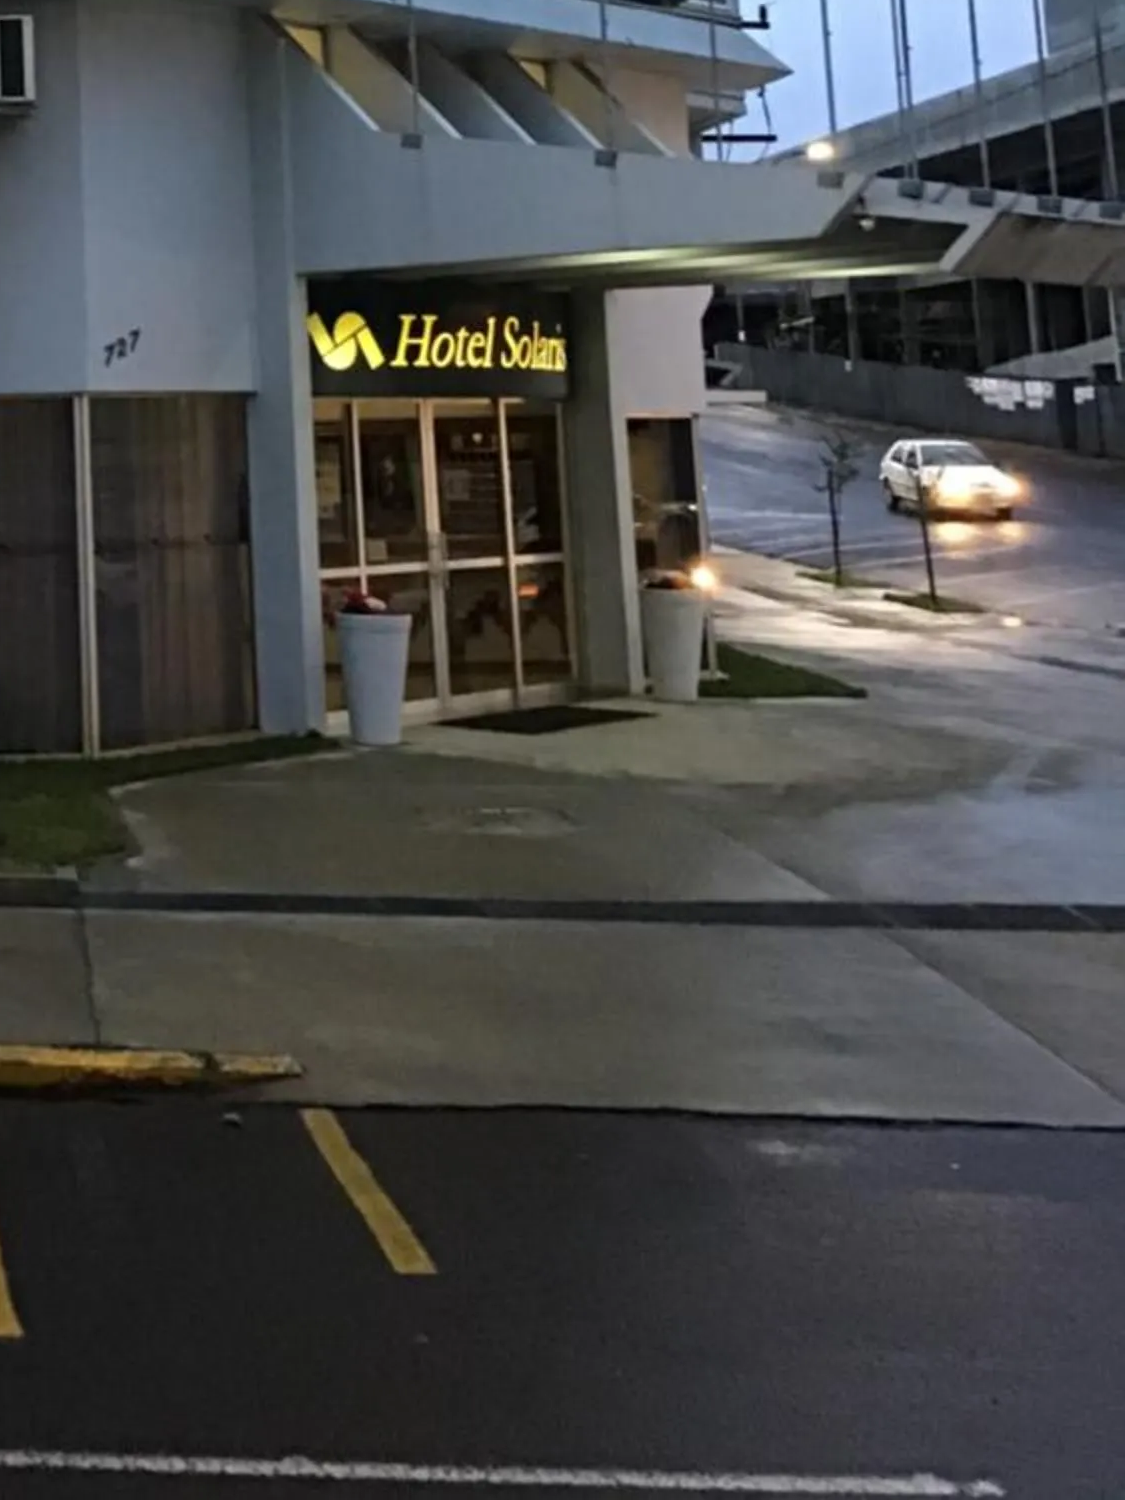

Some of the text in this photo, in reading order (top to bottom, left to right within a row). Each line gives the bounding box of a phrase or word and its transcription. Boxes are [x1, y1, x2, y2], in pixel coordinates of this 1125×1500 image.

[103, 327, 141, 368] 727
[389, 314, 567, 372] Hotel Solaris
